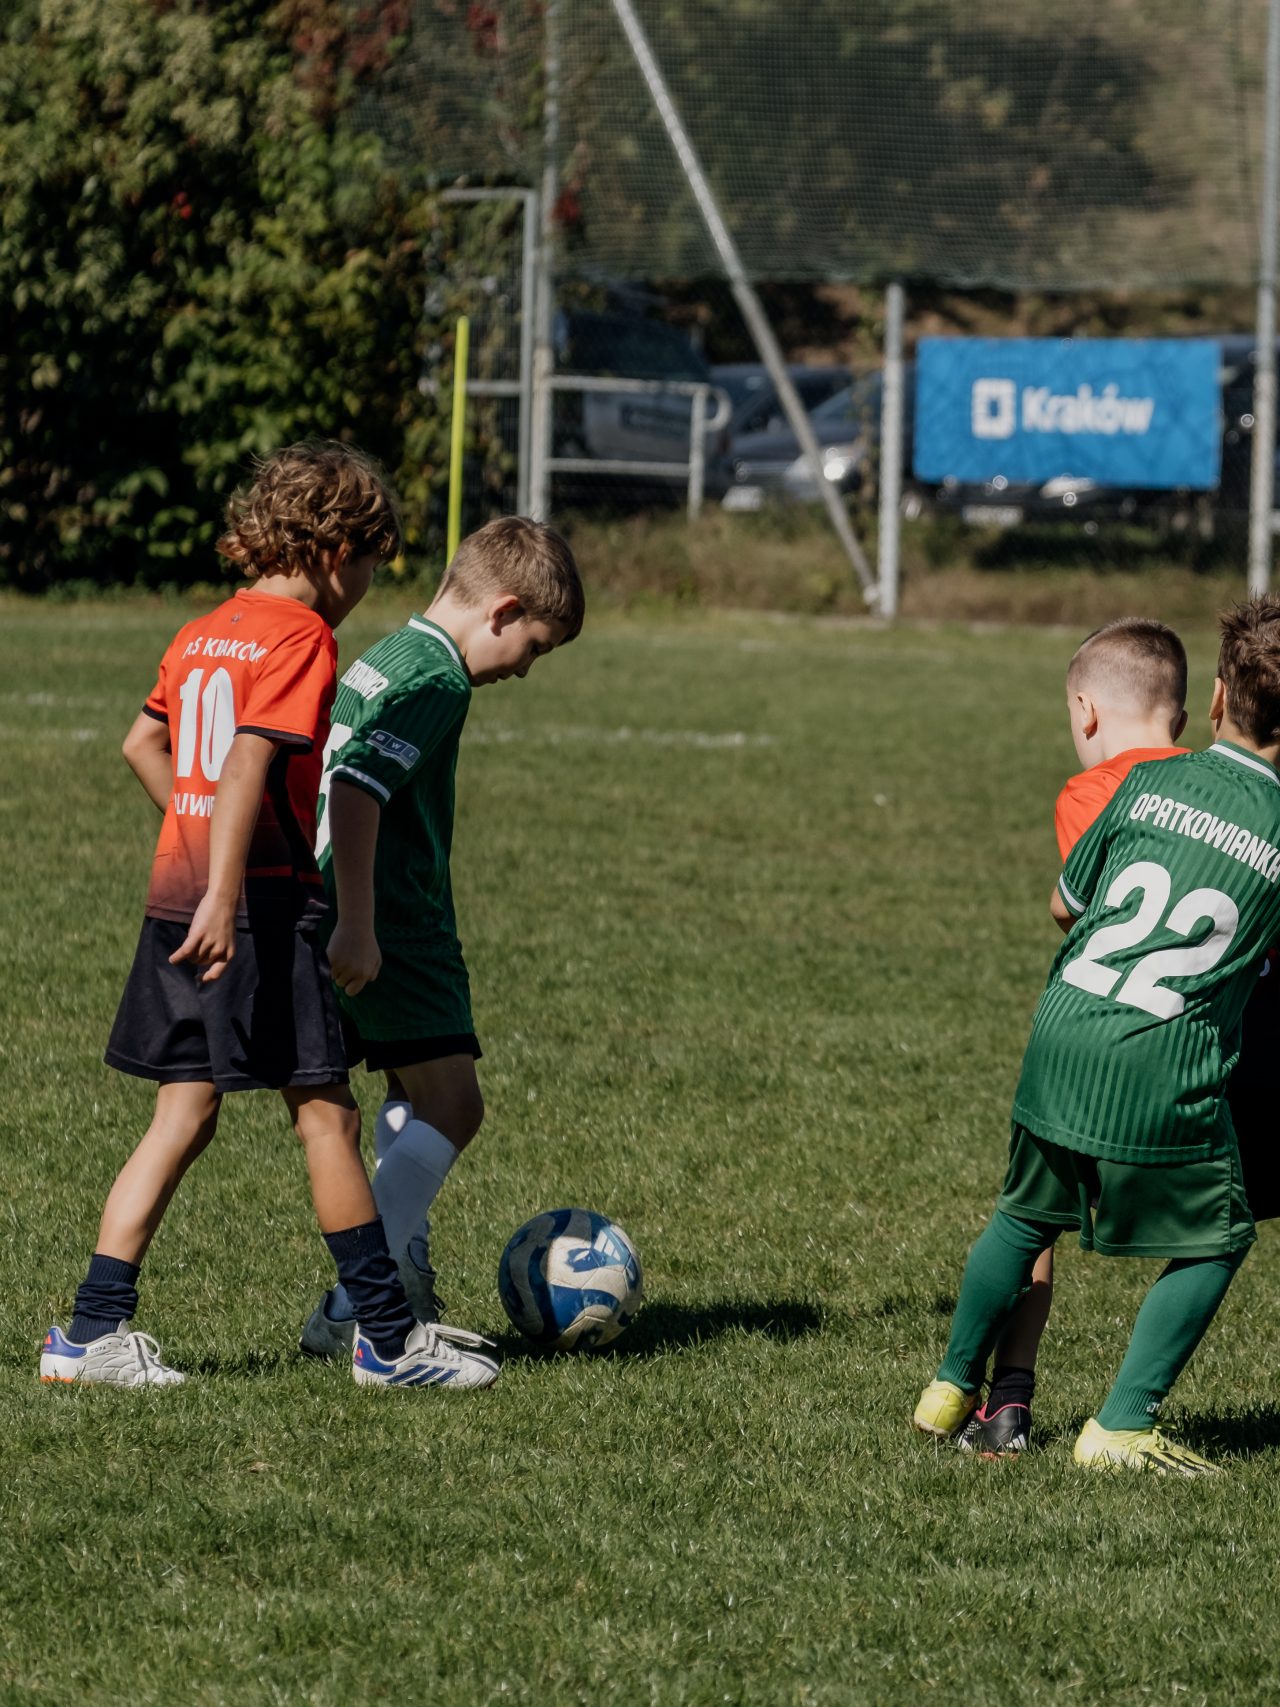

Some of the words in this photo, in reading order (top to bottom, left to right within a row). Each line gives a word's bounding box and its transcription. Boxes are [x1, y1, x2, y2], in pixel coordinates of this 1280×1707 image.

[1022, 383, 1155, 435] Kraków
[177, 667, 235, 782] 10
[1062, 861, 1240, 1021] 22
